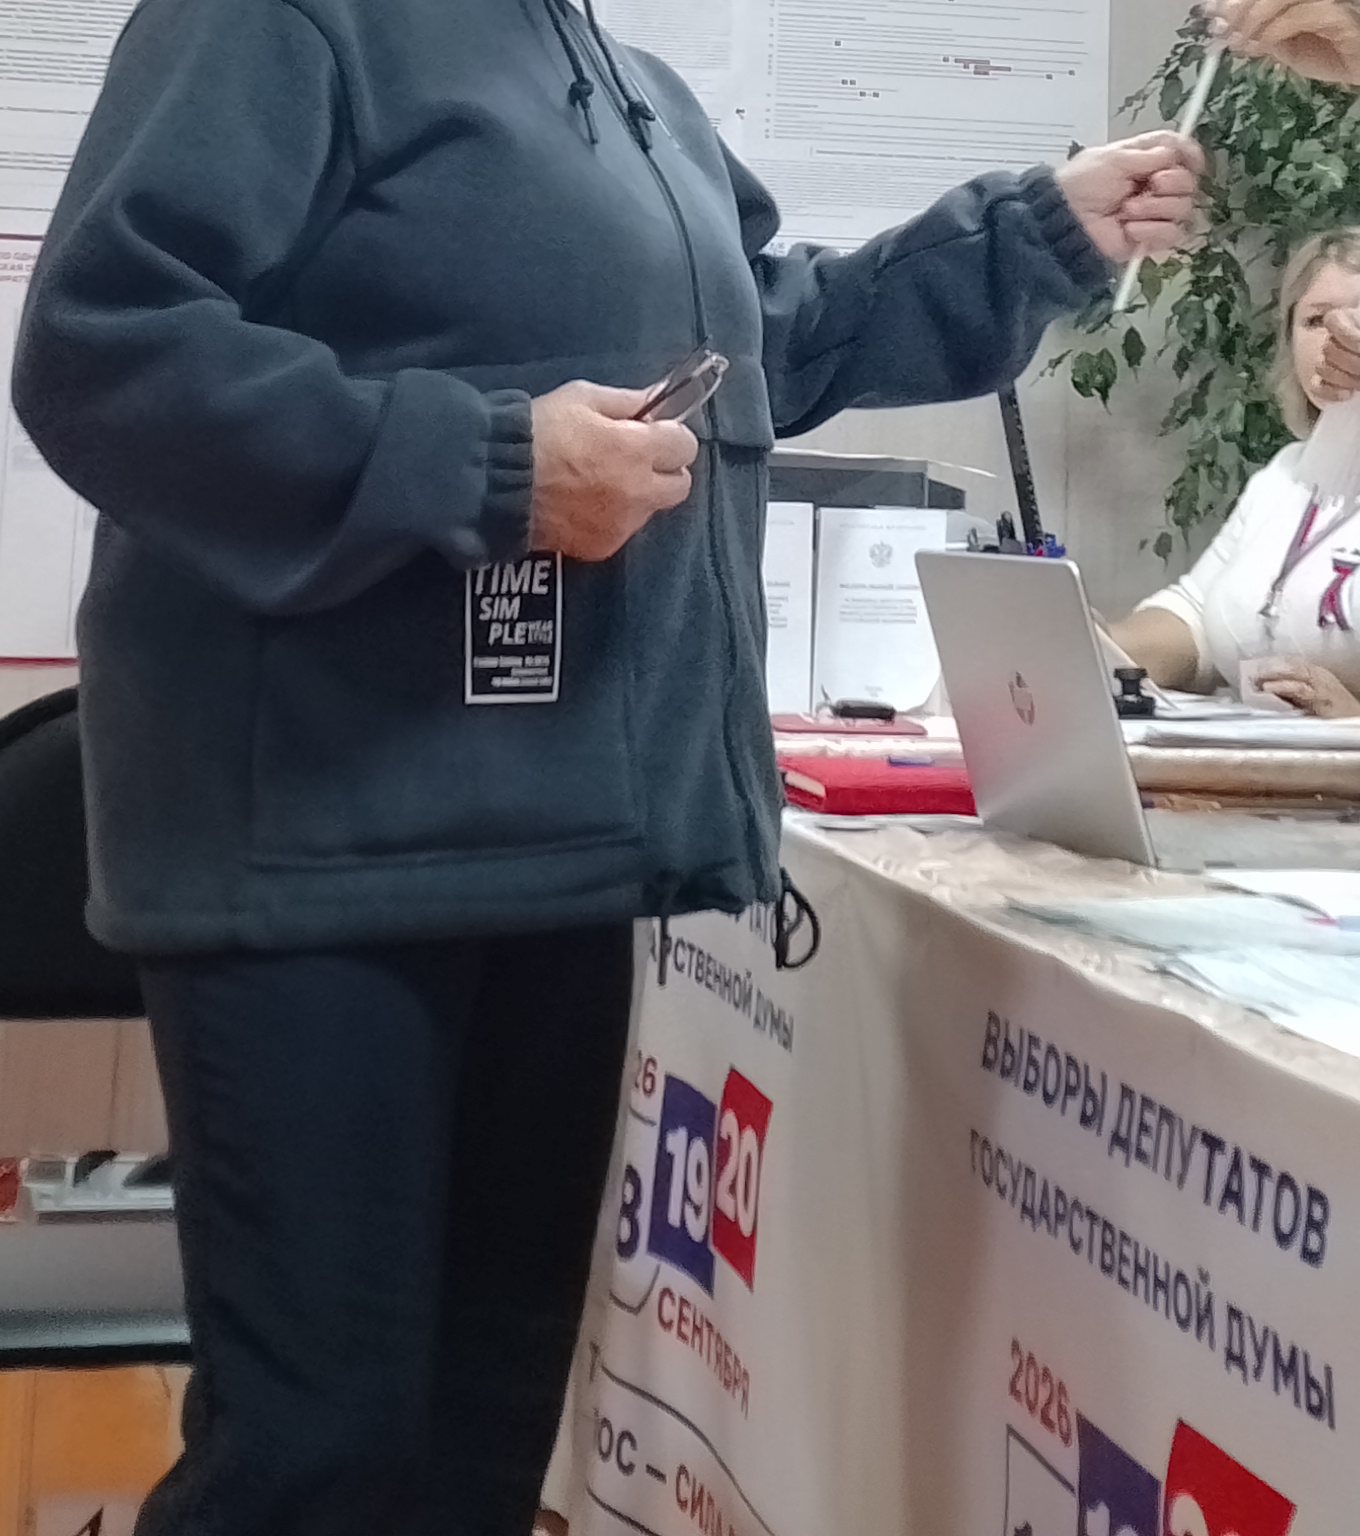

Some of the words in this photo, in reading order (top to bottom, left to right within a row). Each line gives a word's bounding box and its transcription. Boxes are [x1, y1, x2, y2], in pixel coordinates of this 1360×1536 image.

[473, 560, 552, 596] TIME
[478, 595, 521, 621] SIM
[665, 1125, 710, 1243] 19
[715, 1108, 760, 1238] 20
[980, 1009, 1109, 1137] ВЫБОРЫ
[1107, 1080, 1332, 1268] ДЕПУТАТОВ
[969, 1127, 1216, 1352] ГОСУДАРСТВЕННОЙ
[1224, 1300, 1337, 1432] ДУМЫ
[657, 1287, 751, 1420] СЕНТЯБРЯ
[1008, 1334, 1073, 1449] 2026
[596, 1416, 638, 1476] ОС
